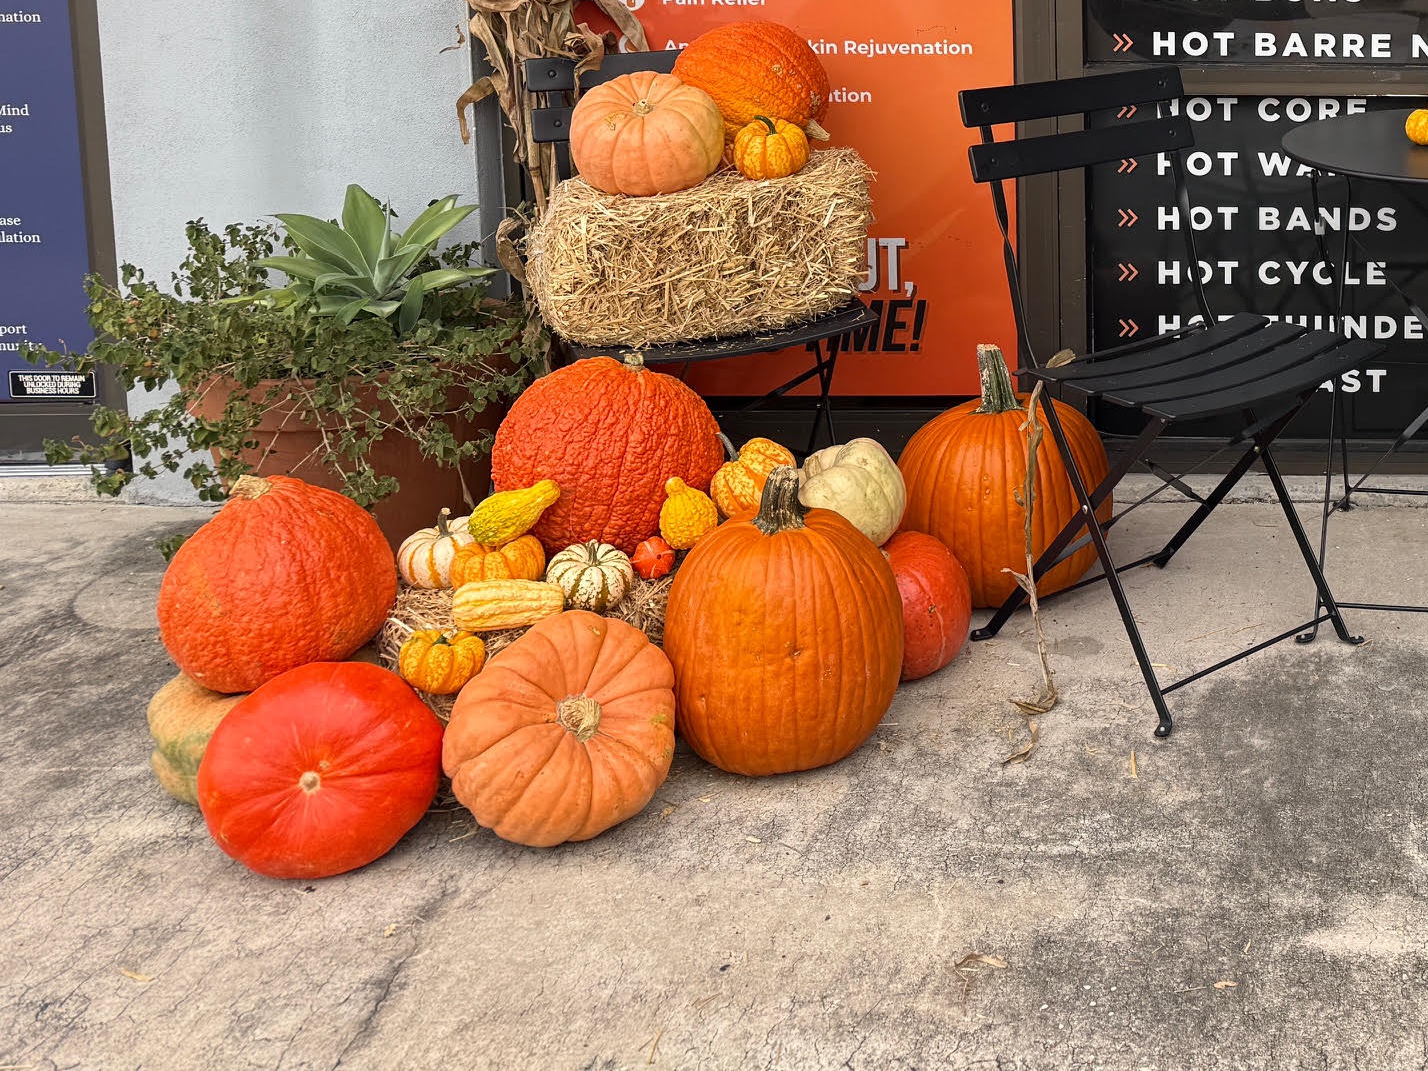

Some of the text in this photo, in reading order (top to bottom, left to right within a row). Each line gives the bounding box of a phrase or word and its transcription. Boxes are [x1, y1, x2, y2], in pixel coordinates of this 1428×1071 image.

[808, 39, 837, 54] kin
[845, 40, 972, 57] Rejuvenation
[1154, 32, 1234, 56] HOT
[1255, 33, 1390, 57] BARRE
[1258, 98, 1367, 121] CORE
[1158, 207, 1397, 232] HOT BANDS
[1159, 261, 1385, 284] HOT CYCLE
